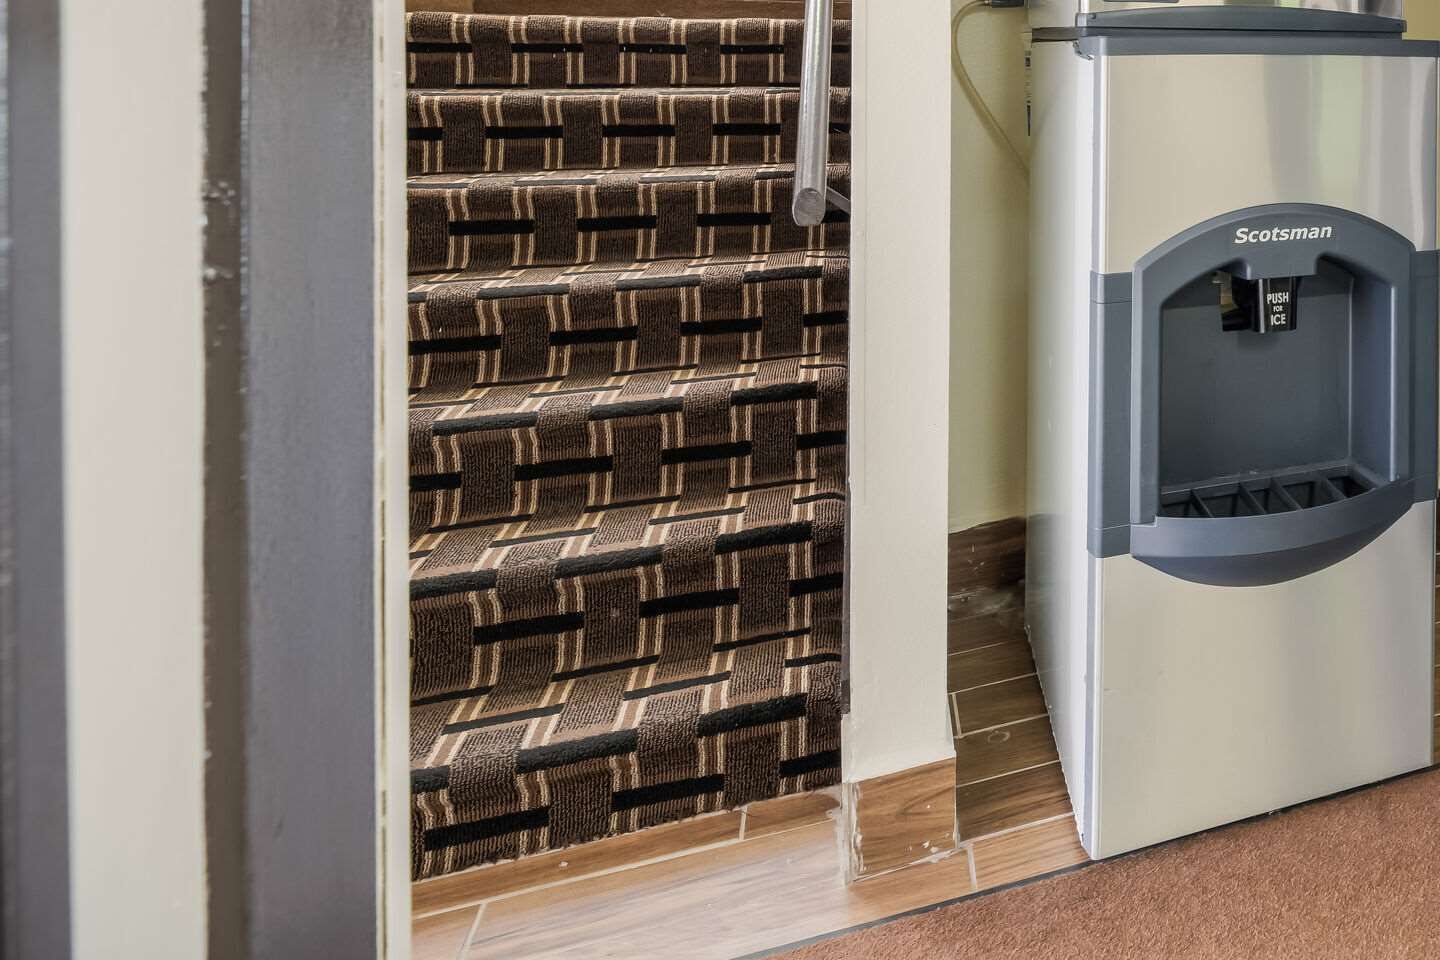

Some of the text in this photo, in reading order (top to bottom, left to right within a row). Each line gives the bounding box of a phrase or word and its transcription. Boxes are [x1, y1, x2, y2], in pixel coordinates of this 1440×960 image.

[1234, 226, 1332, 244] Scotsman
[1266, 292, 1289, 304] PUSH
[1271, 314, 1286, 326] ICE
